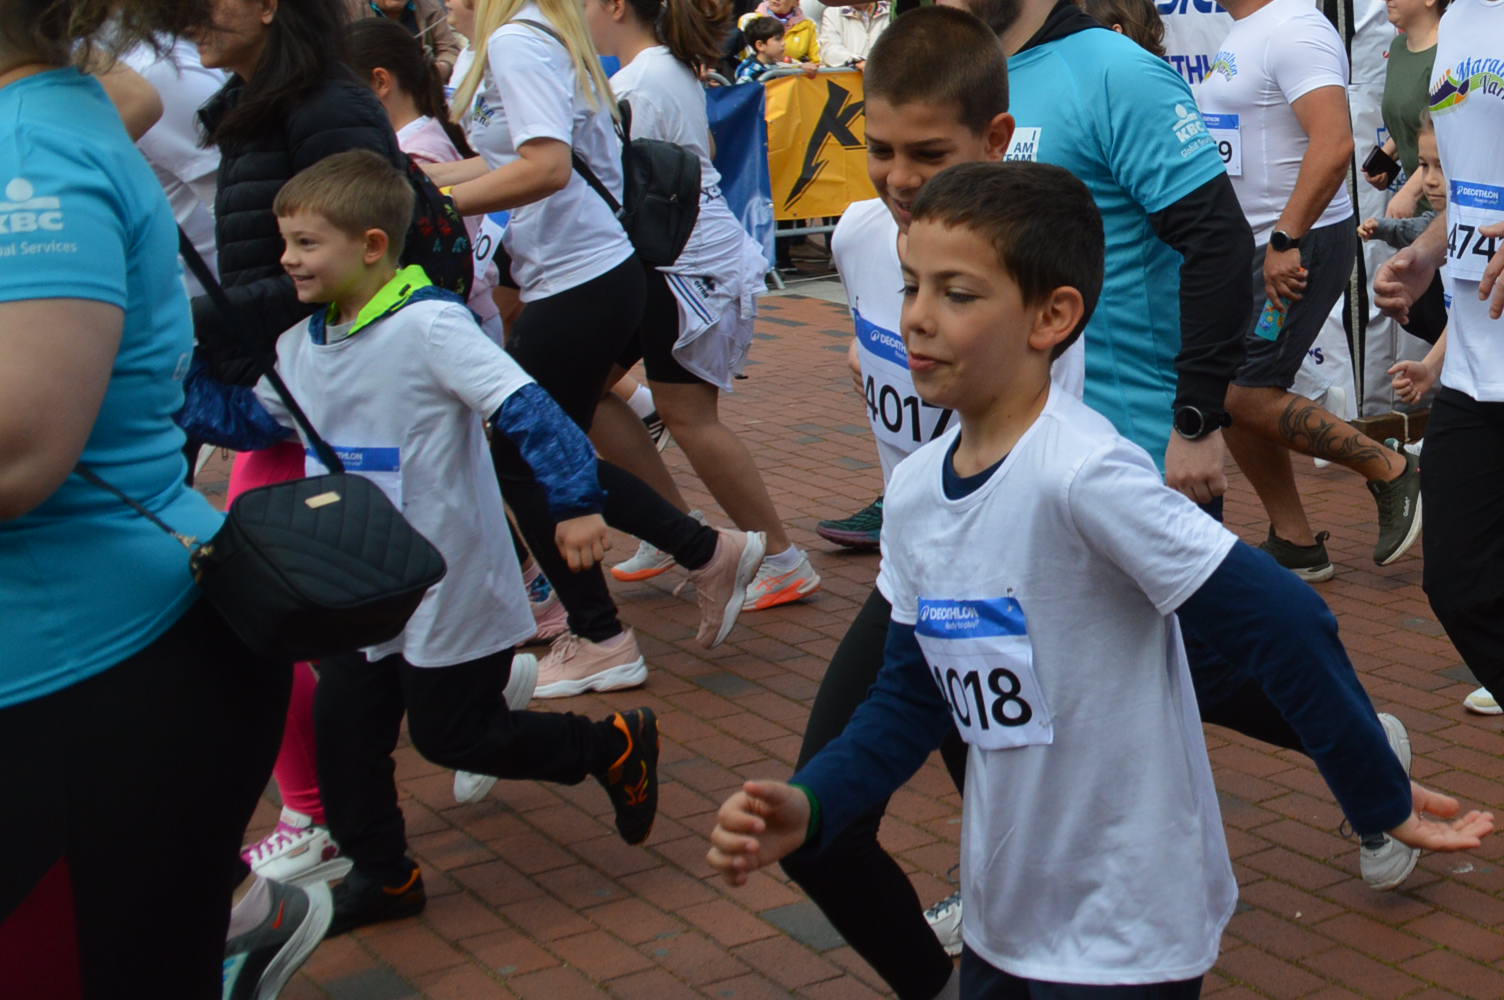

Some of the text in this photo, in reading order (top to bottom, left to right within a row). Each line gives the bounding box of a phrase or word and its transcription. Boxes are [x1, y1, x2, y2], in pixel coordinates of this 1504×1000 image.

[1014, 142, 1034, 153] AM
[1214, 140, 1233, 164] 9
[1463, 187, 1499, 200] DECATHLON
[20, 240, 78, 256] Services
[1447, 222, 1504, 263] 474
[866, 374, 954, 443] 4017
